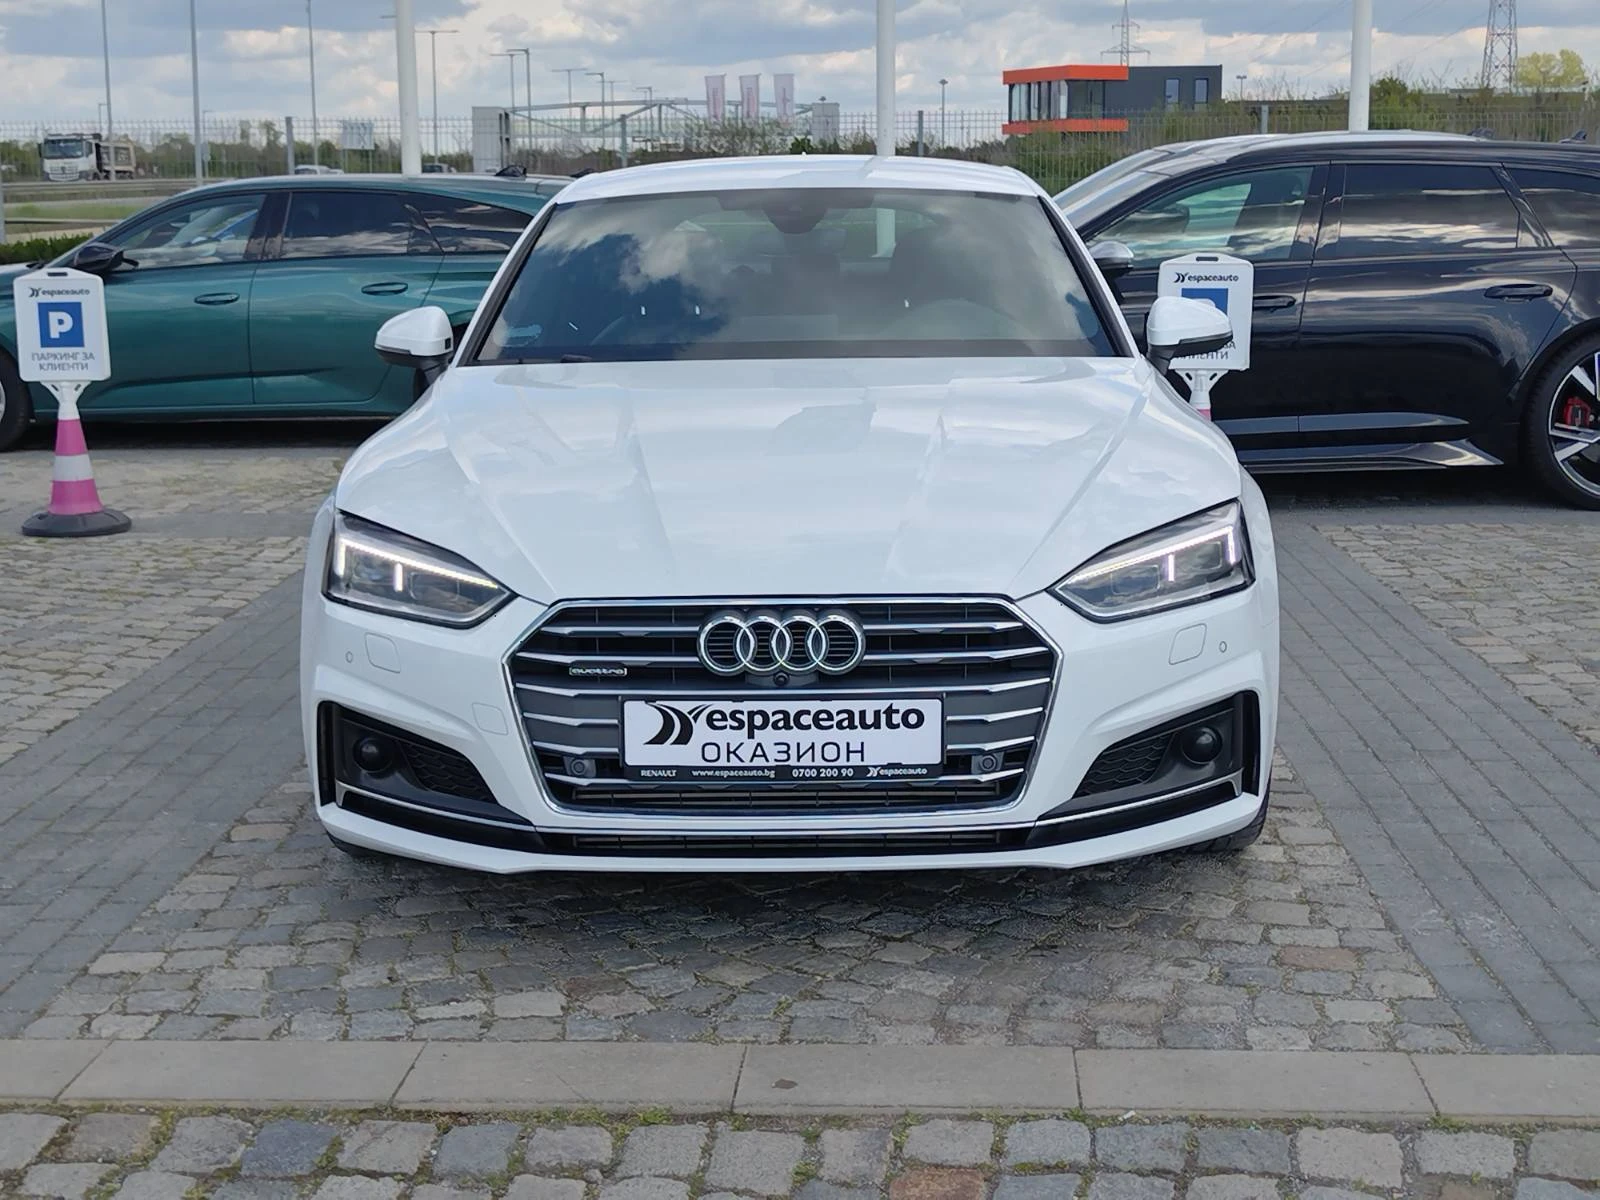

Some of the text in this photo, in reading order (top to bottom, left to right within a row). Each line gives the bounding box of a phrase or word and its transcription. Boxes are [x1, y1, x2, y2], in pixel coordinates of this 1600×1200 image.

[1188, 274, 1239, 283] espaceauto
[41, 288, 90, 297] espaceauto
[48, 311, 73, 339] P
[31, 352, 95, 361] ПАРКИНГ ЗА
[39, 363, 88, 371] КЛИЕНТИ
[570, 667, 625, 676] quattro
[705, 703, 925, 739] espaceauto
[701, 742, 865, 763] ОКАЗИОН
[640, 769, 677, 778] RENAULT
[691, 768, 776, 779] www.espaceauto.bg
[792, 768, 854, 777] 0700 200 90
[879, 767, 928, 777] espaceauto
